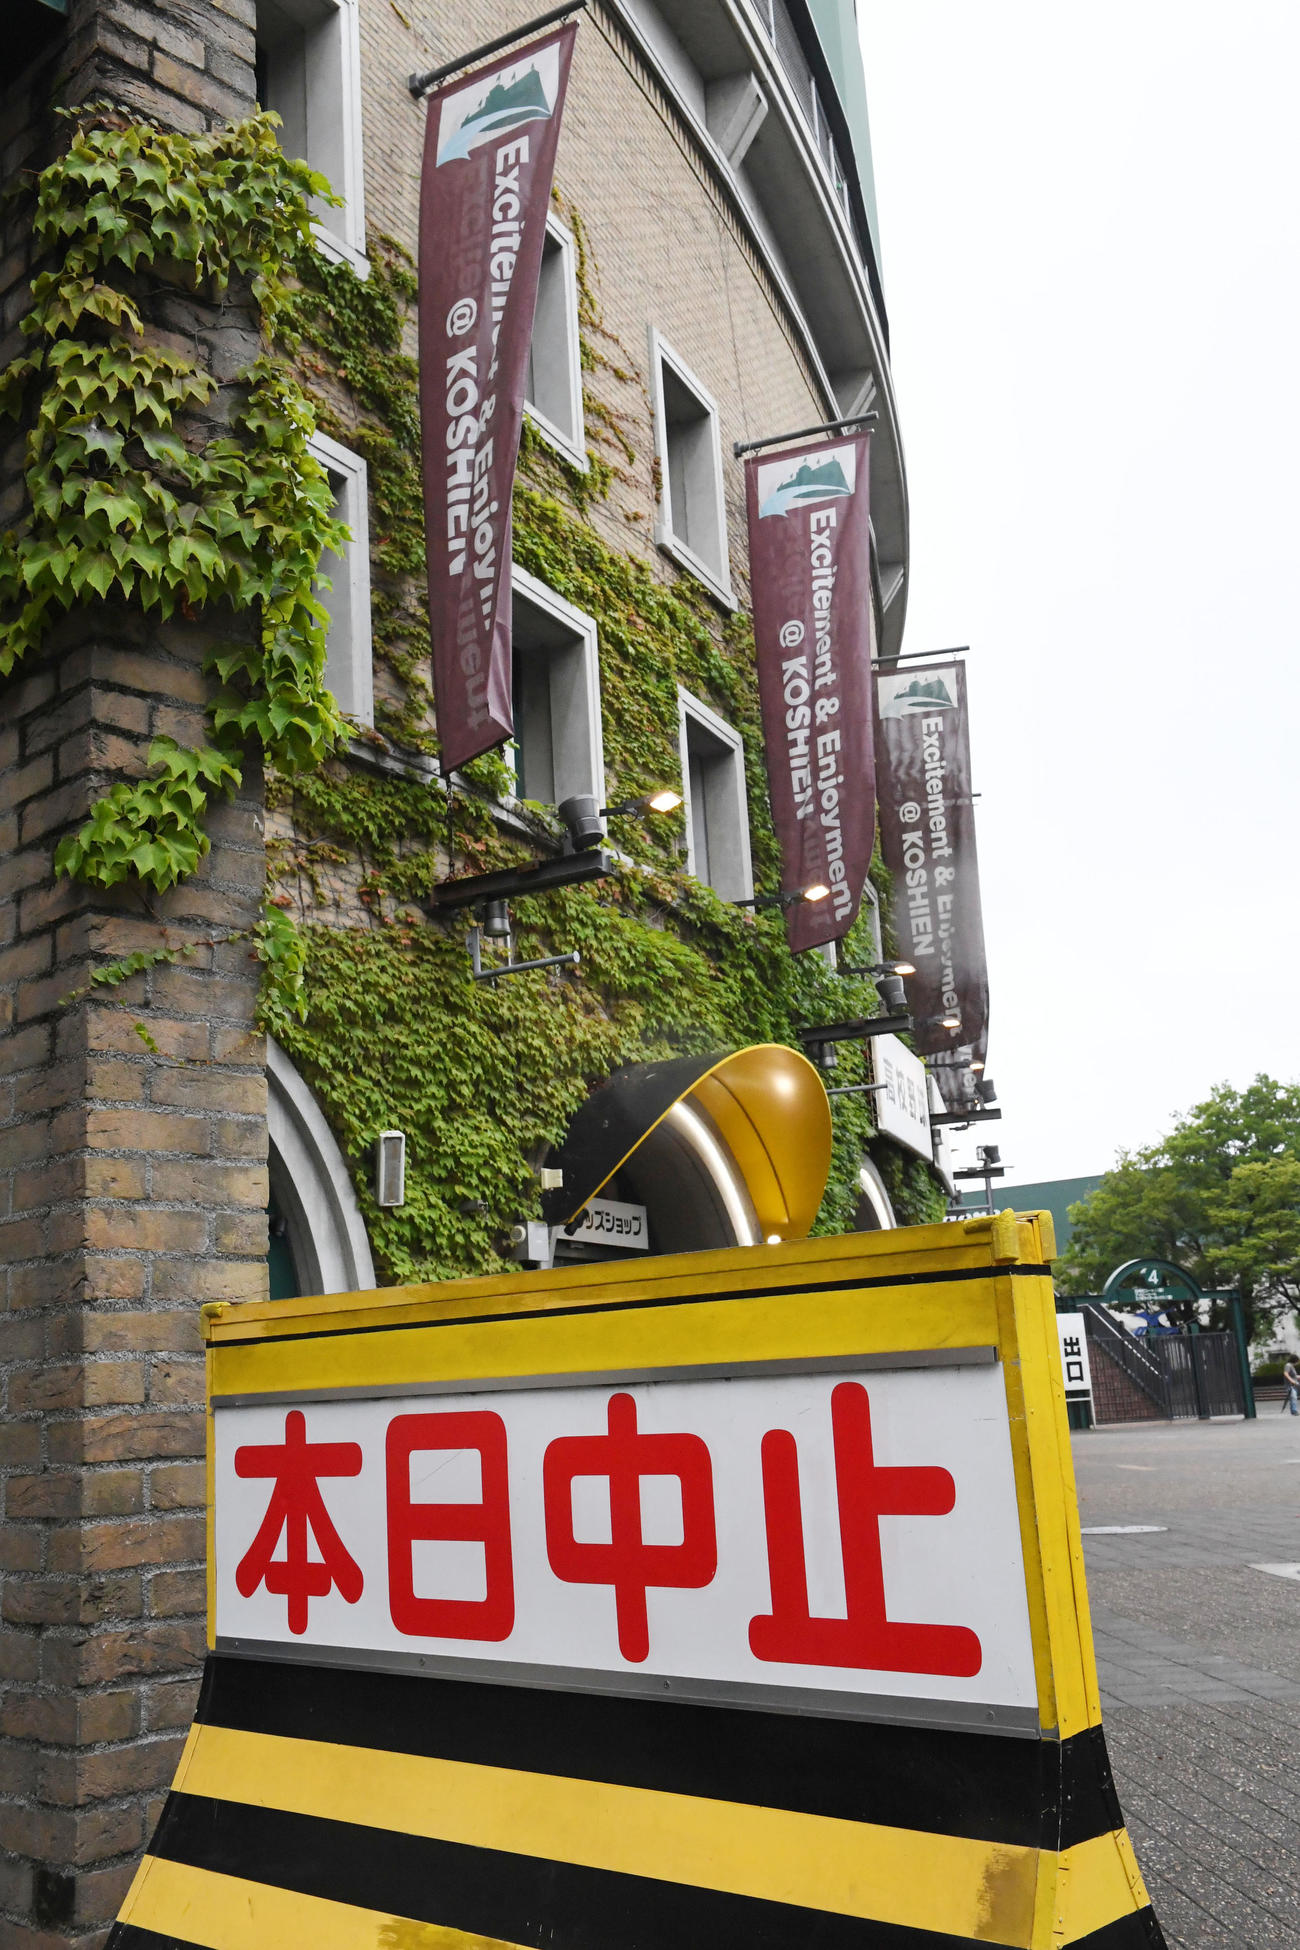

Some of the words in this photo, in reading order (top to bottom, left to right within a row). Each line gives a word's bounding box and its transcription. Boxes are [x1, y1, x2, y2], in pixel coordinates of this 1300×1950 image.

[488, 135, 529, 380] Excite
[446, 297, 478, 338] @
[470, 437, 499, 631] Enjoy
[779, 619, 805, 649] @
[810, 507, 838, 690] Excitement
[782, 656, 815, 820] KOSHIEN
[814, 697, 840, 727] &
[816, 730, 853, 922] Enjoyment
[899, 801, 921, 824] @
[921, 716, 953, 859] Excitement
[902, 830, 935, 957] KOSHIEN
[934, 866, 955, 887] &
[585, 1210, 642, 1236] ッズショップ
[1147, 1268, 1159, 1285] 4
[1063, 1336, 1084, 1383] 出口
[234, 1381, 982, 1678] 本日中止
